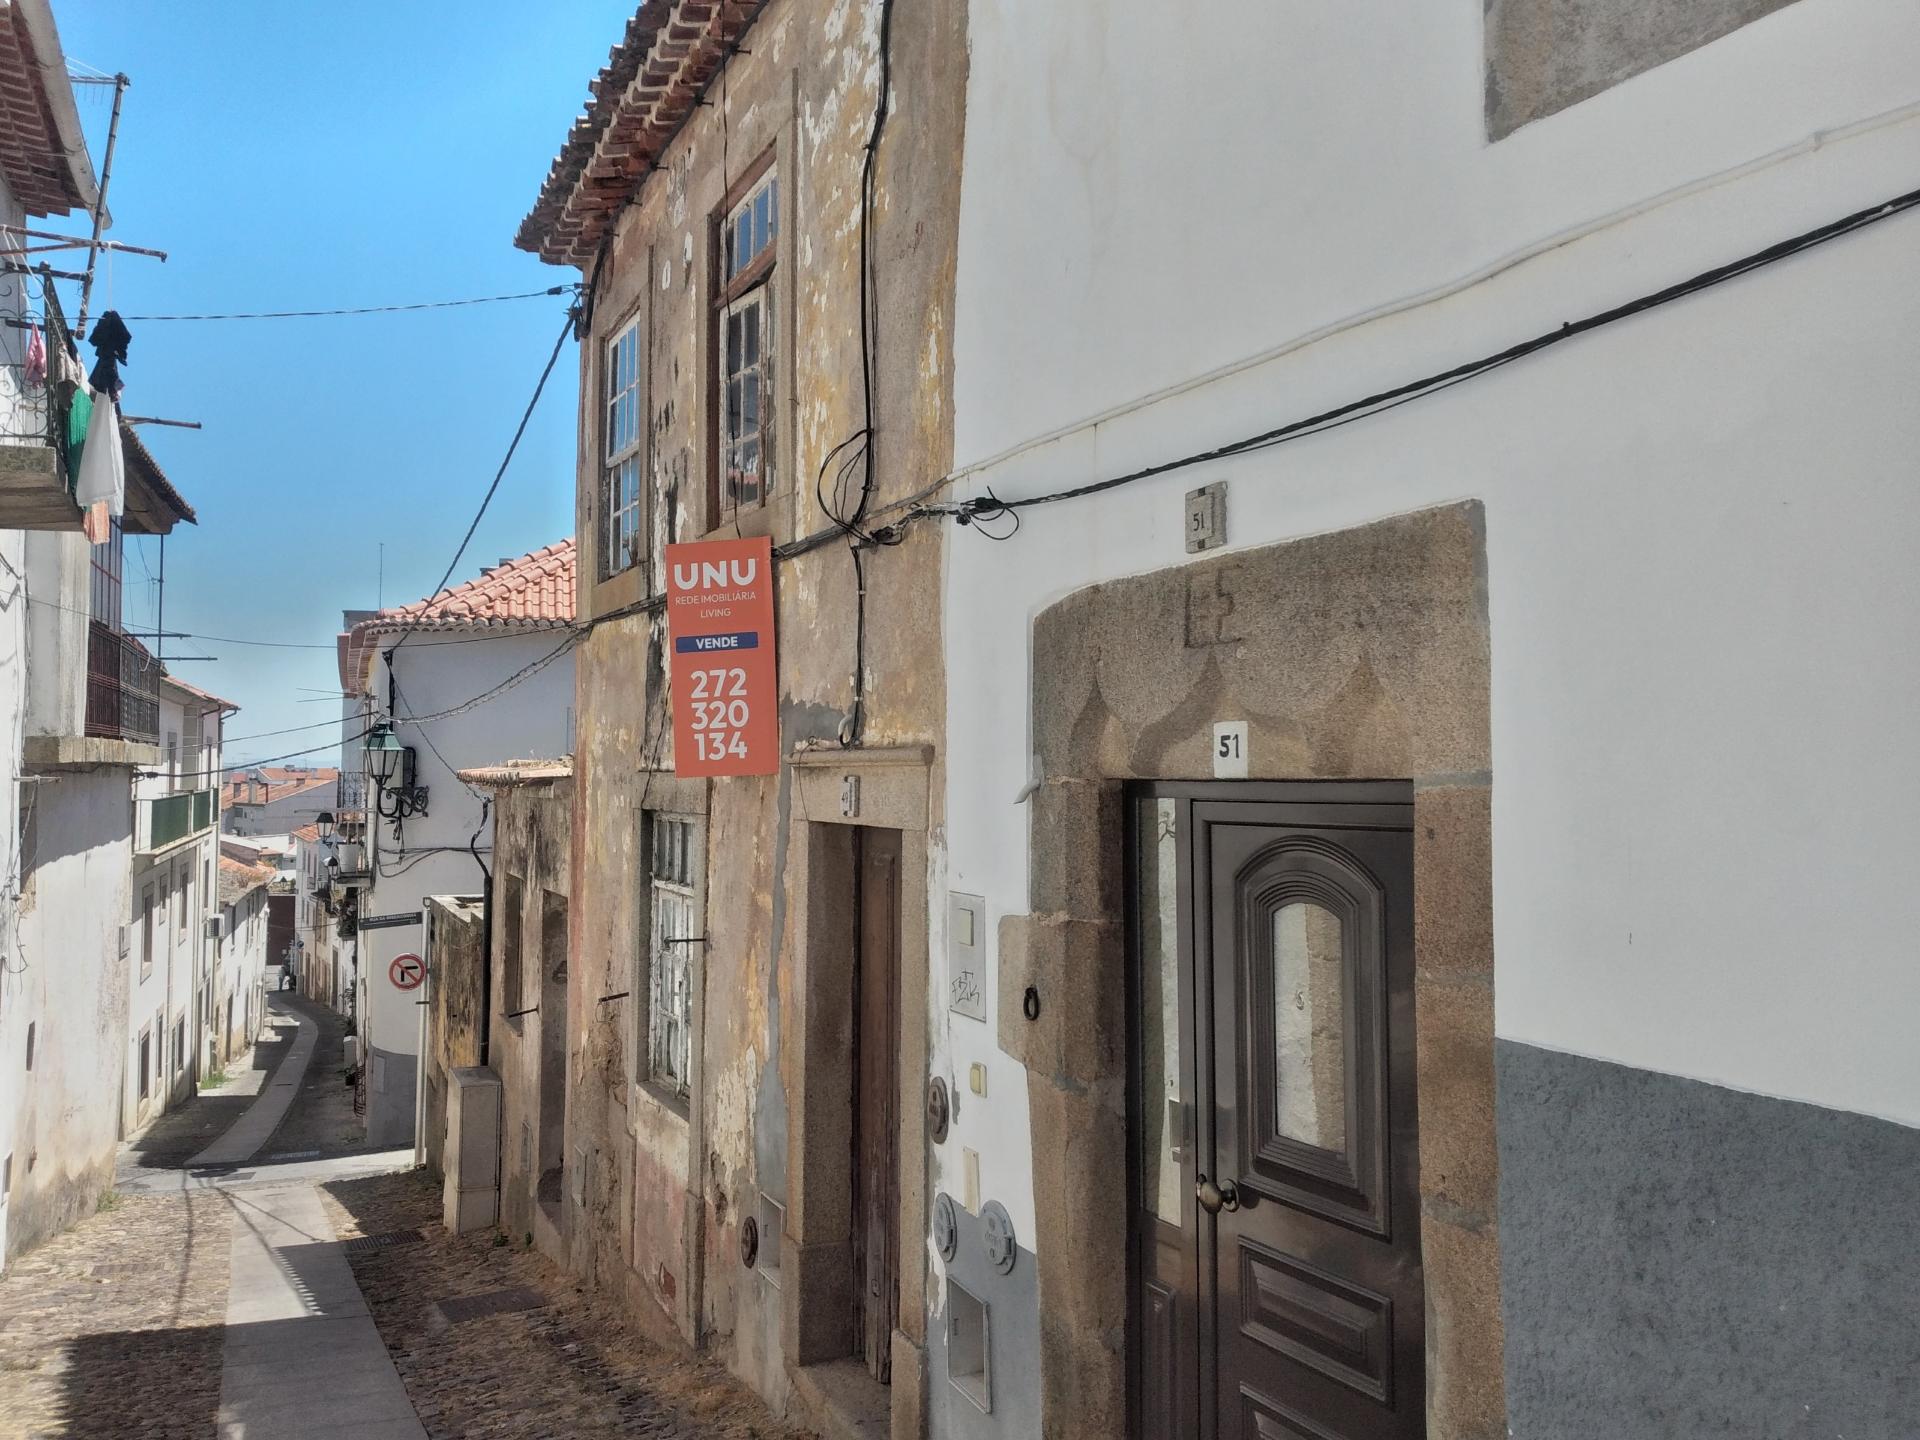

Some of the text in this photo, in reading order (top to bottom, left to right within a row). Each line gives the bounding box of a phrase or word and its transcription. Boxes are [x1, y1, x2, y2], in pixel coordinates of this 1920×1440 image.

[1193, 512, 1204, 531] 51
[674, 558, 756, 590] UNU
[675, 590, 756, 606] REDE IMOBILIÁRIA
[701, 608, 731, 618] LIVING
[696, 636, 738, 649] VENDE
[690, 668, 747, 698] 272
[691, 699, 749, 730] 320
[694, 731, 747, 760] 134
[1219, 733, 1239, 759] 51
